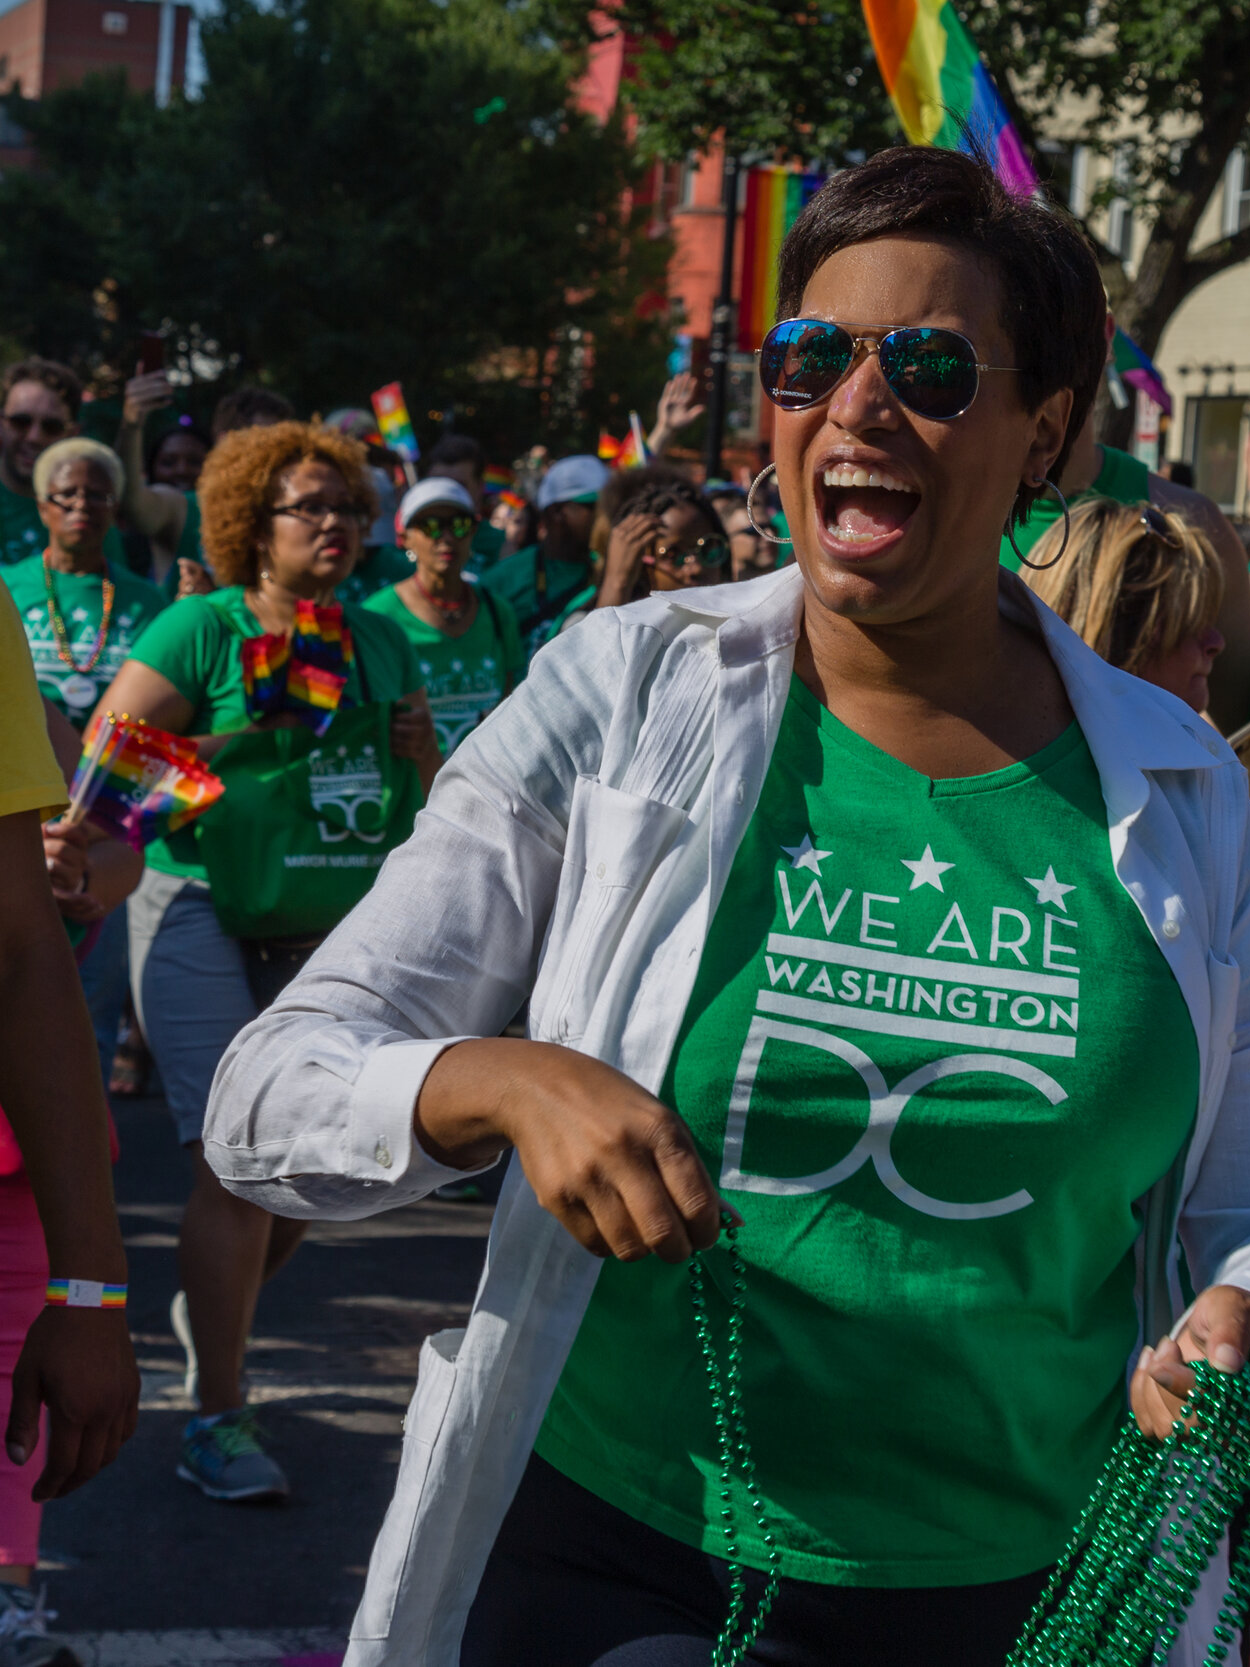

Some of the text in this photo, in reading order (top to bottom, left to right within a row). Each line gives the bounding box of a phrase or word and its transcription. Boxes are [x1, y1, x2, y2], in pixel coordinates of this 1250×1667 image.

[777, 869, 1081, 974] WE ARE
[764, 956, 1080, 1032] WASHINGTON
[719, 1014, 1069, 1221] DC
